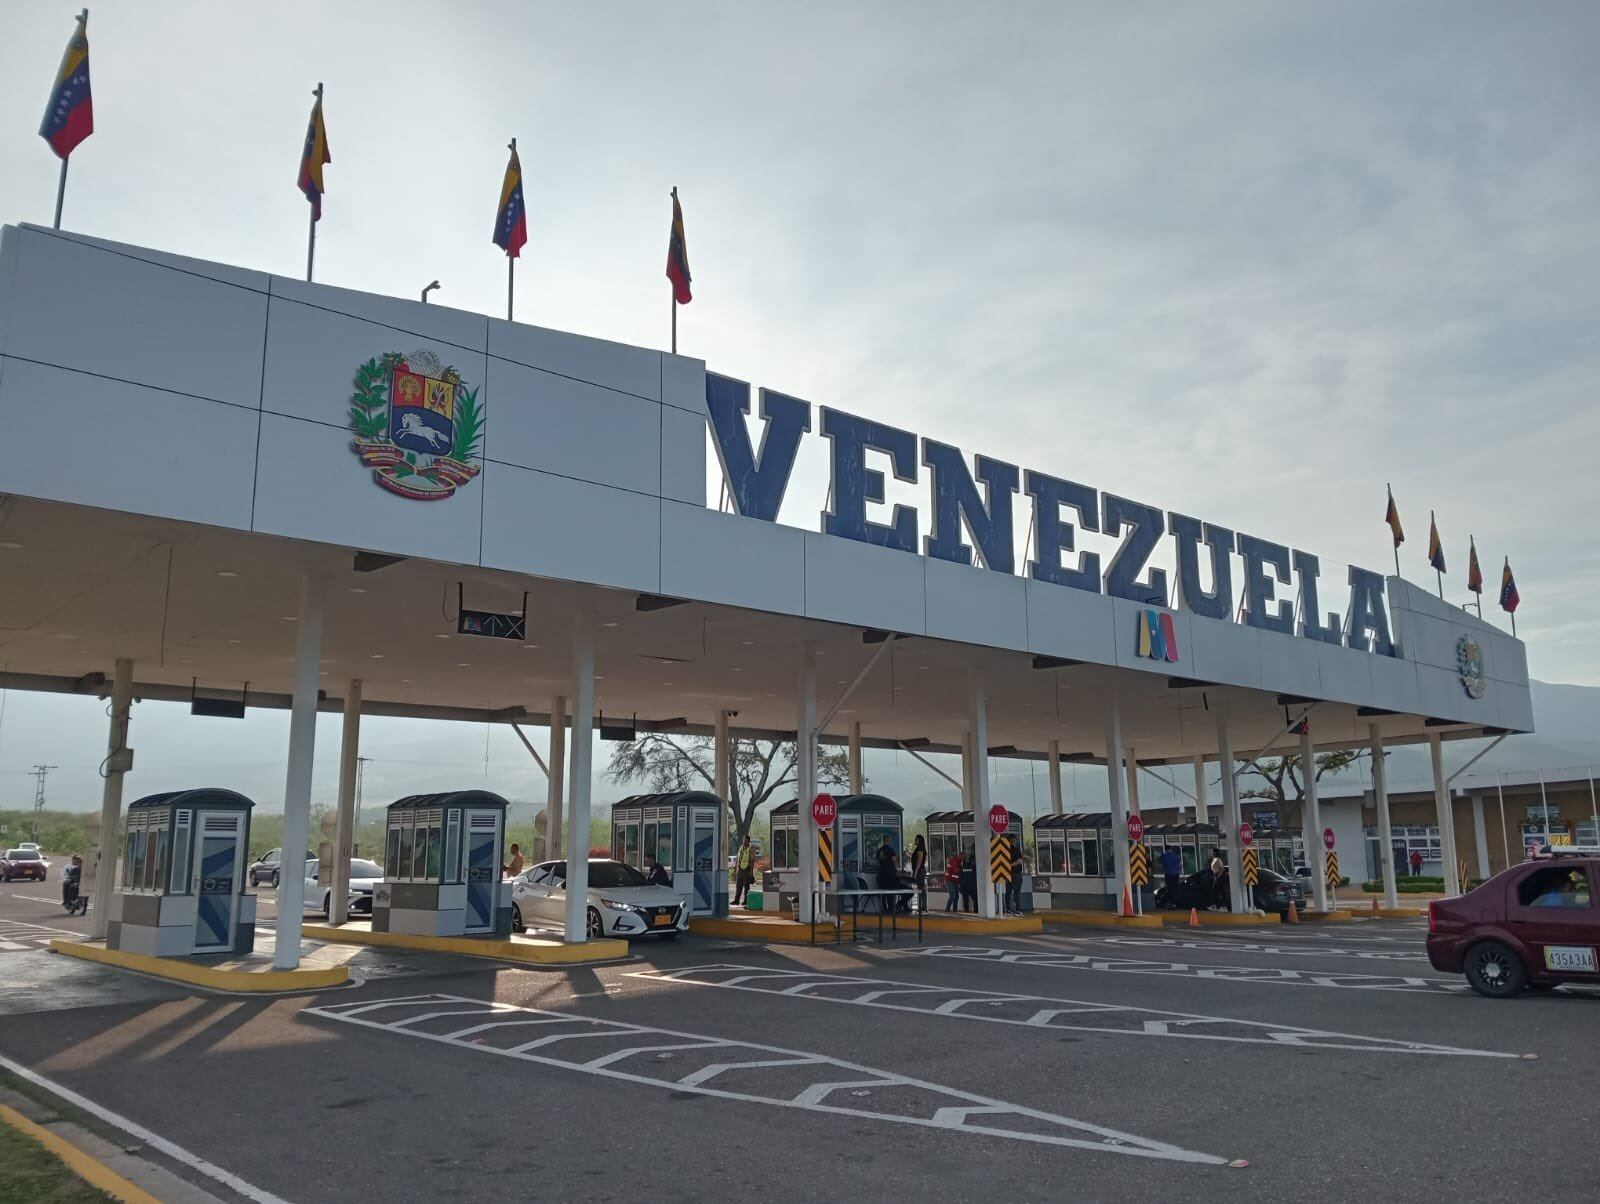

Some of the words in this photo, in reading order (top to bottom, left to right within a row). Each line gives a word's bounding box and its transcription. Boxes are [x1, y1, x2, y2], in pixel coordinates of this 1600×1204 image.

[705, 370, 1399, 658] VENEZUELA
[814, 804, 833, 816] PARE
[990, 814, 1007, 824] PARE
